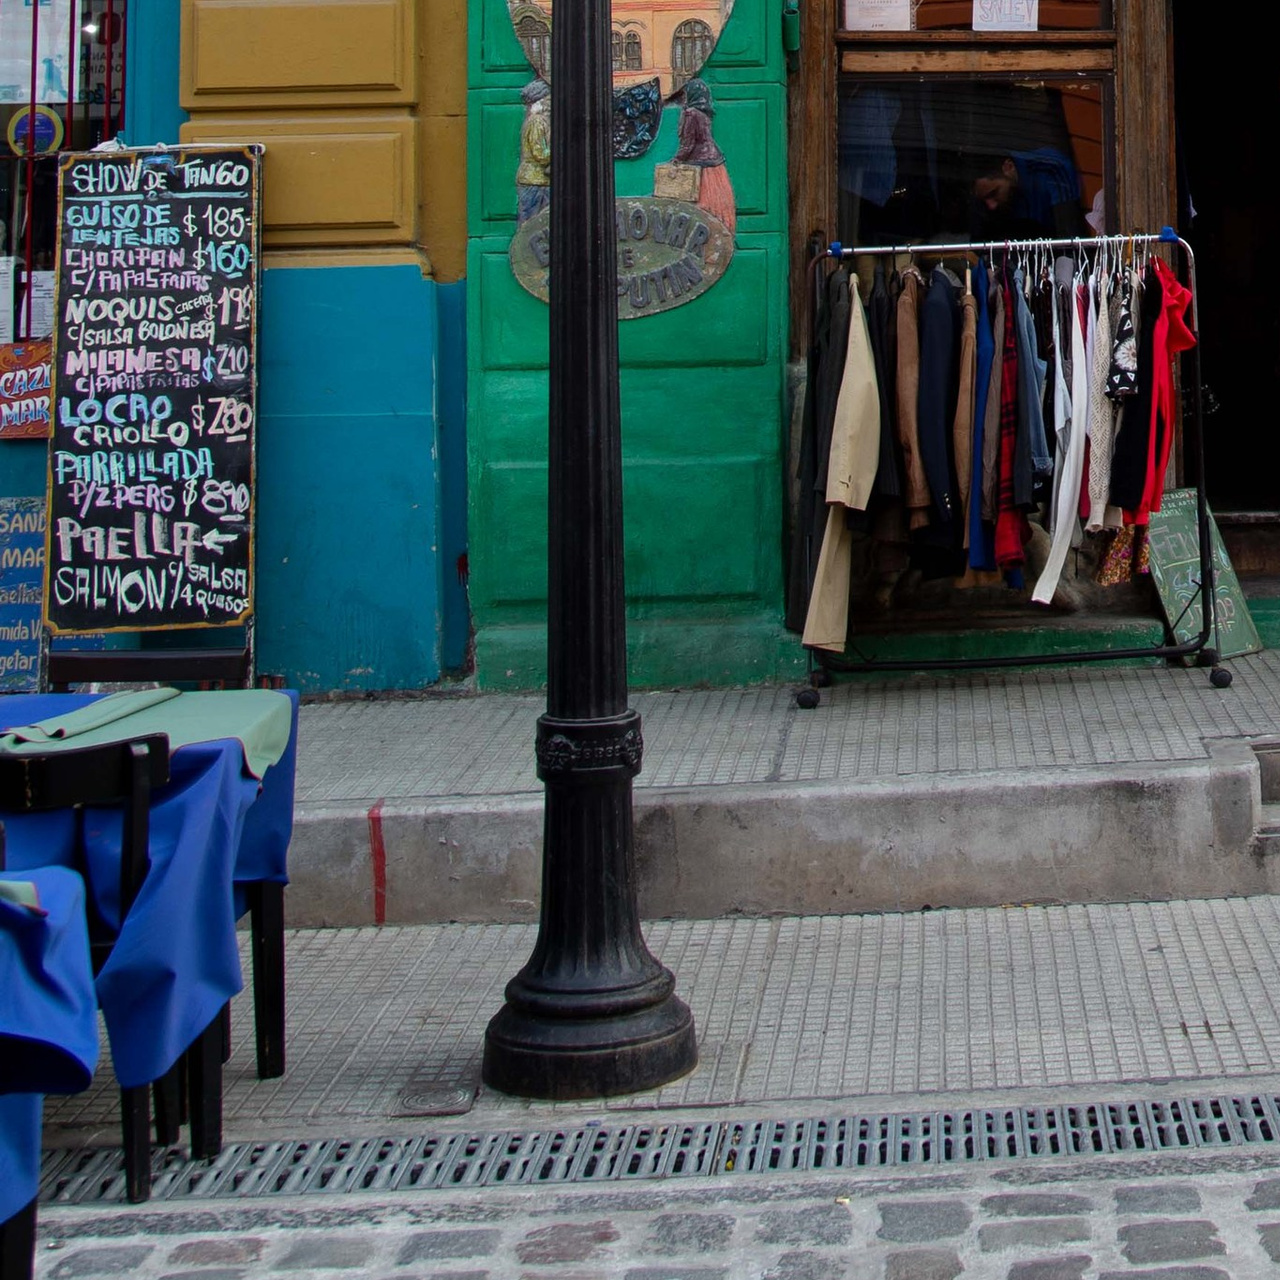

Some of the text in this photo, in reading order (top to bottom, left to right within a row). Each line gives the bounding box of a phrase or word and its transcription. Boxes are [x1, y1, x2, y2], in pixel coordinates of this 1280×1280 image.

[71, 158, 250, 193] SHOW DE TANGO
[143, 204, 171, 226] DE
[71, 227, 181, 248] LENTEJAS
[65, 248, 186, 271] CHORIPAN
[65, 345, 201, 376] MILANESA
[54, 447, 215, 485] PARRILLADA
[56, 511, 203, 567] PAELLA
[54, 565, 166, 616] SALMON
